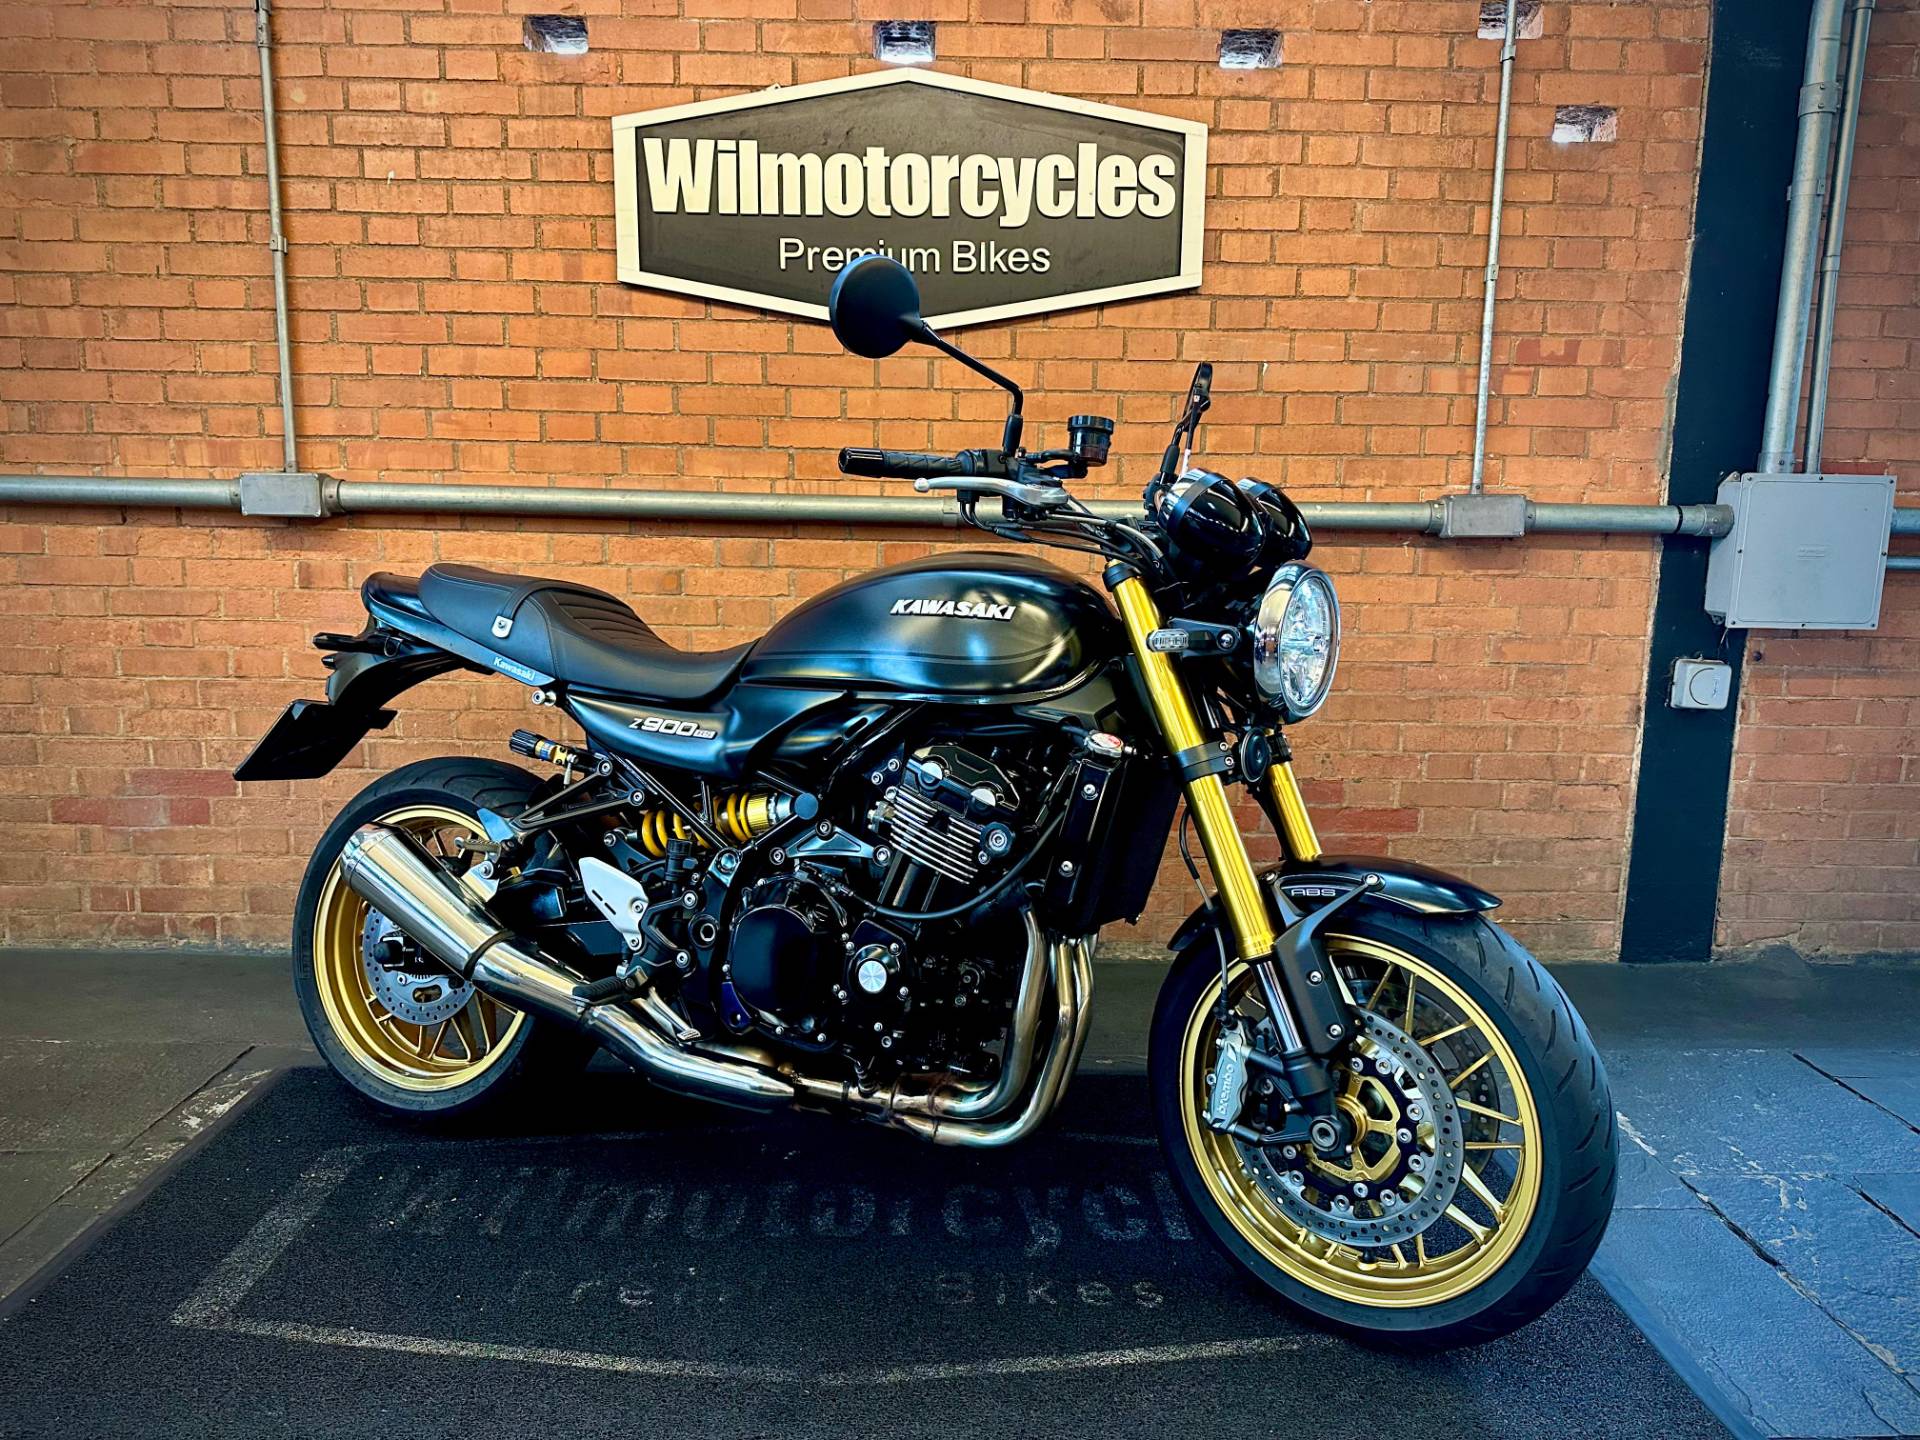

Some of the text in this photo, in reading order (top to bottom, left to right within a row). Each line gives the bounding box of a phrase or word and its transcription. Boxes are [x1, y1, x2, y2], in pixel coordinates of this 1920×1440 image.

[642, 137, 1176, 228] Wilmotorcycles
[889, 599, 1017, 621] KAWASAKI
[493, 656, 536, 681] Kawasaki
[1291, 888, 1336, 897] ABS
[1217, 1063, 1235, 1116] brembo
